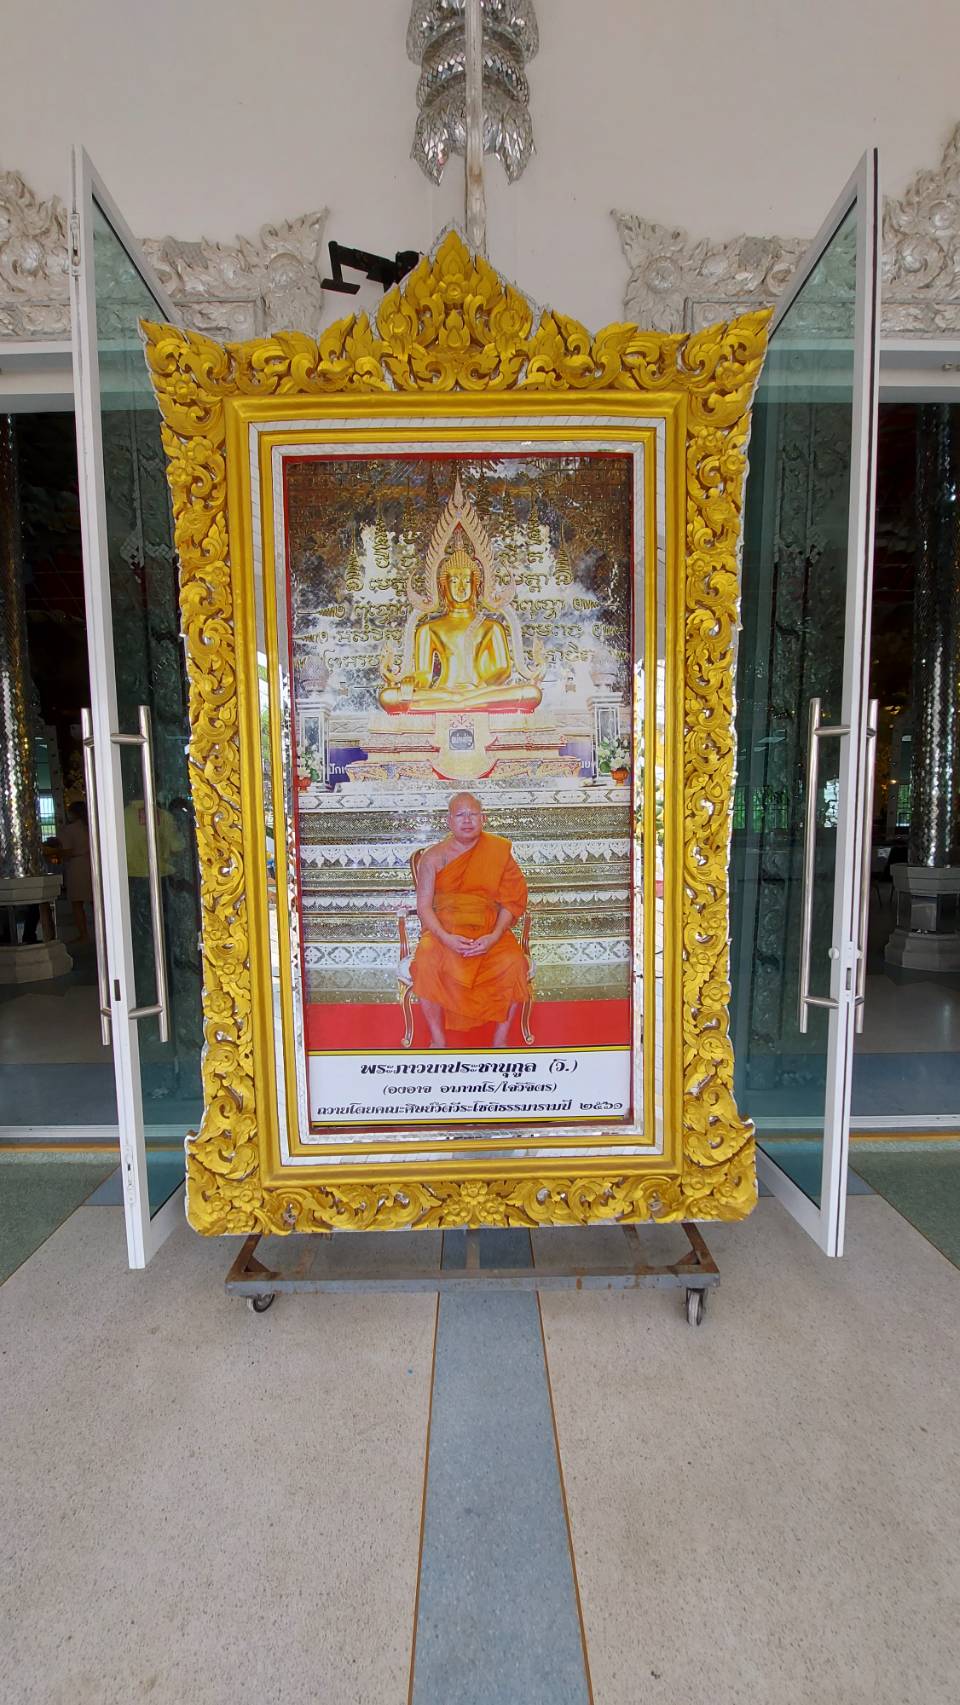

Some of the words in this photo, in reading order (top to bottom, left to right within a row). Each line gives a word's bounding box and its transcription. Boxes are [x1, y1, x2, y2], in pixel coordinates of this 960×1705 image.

[360, 1061, 537, 1079] พระภาวนาประชานุกูล
[548, 1058, 578, 1074] (วิ.)
